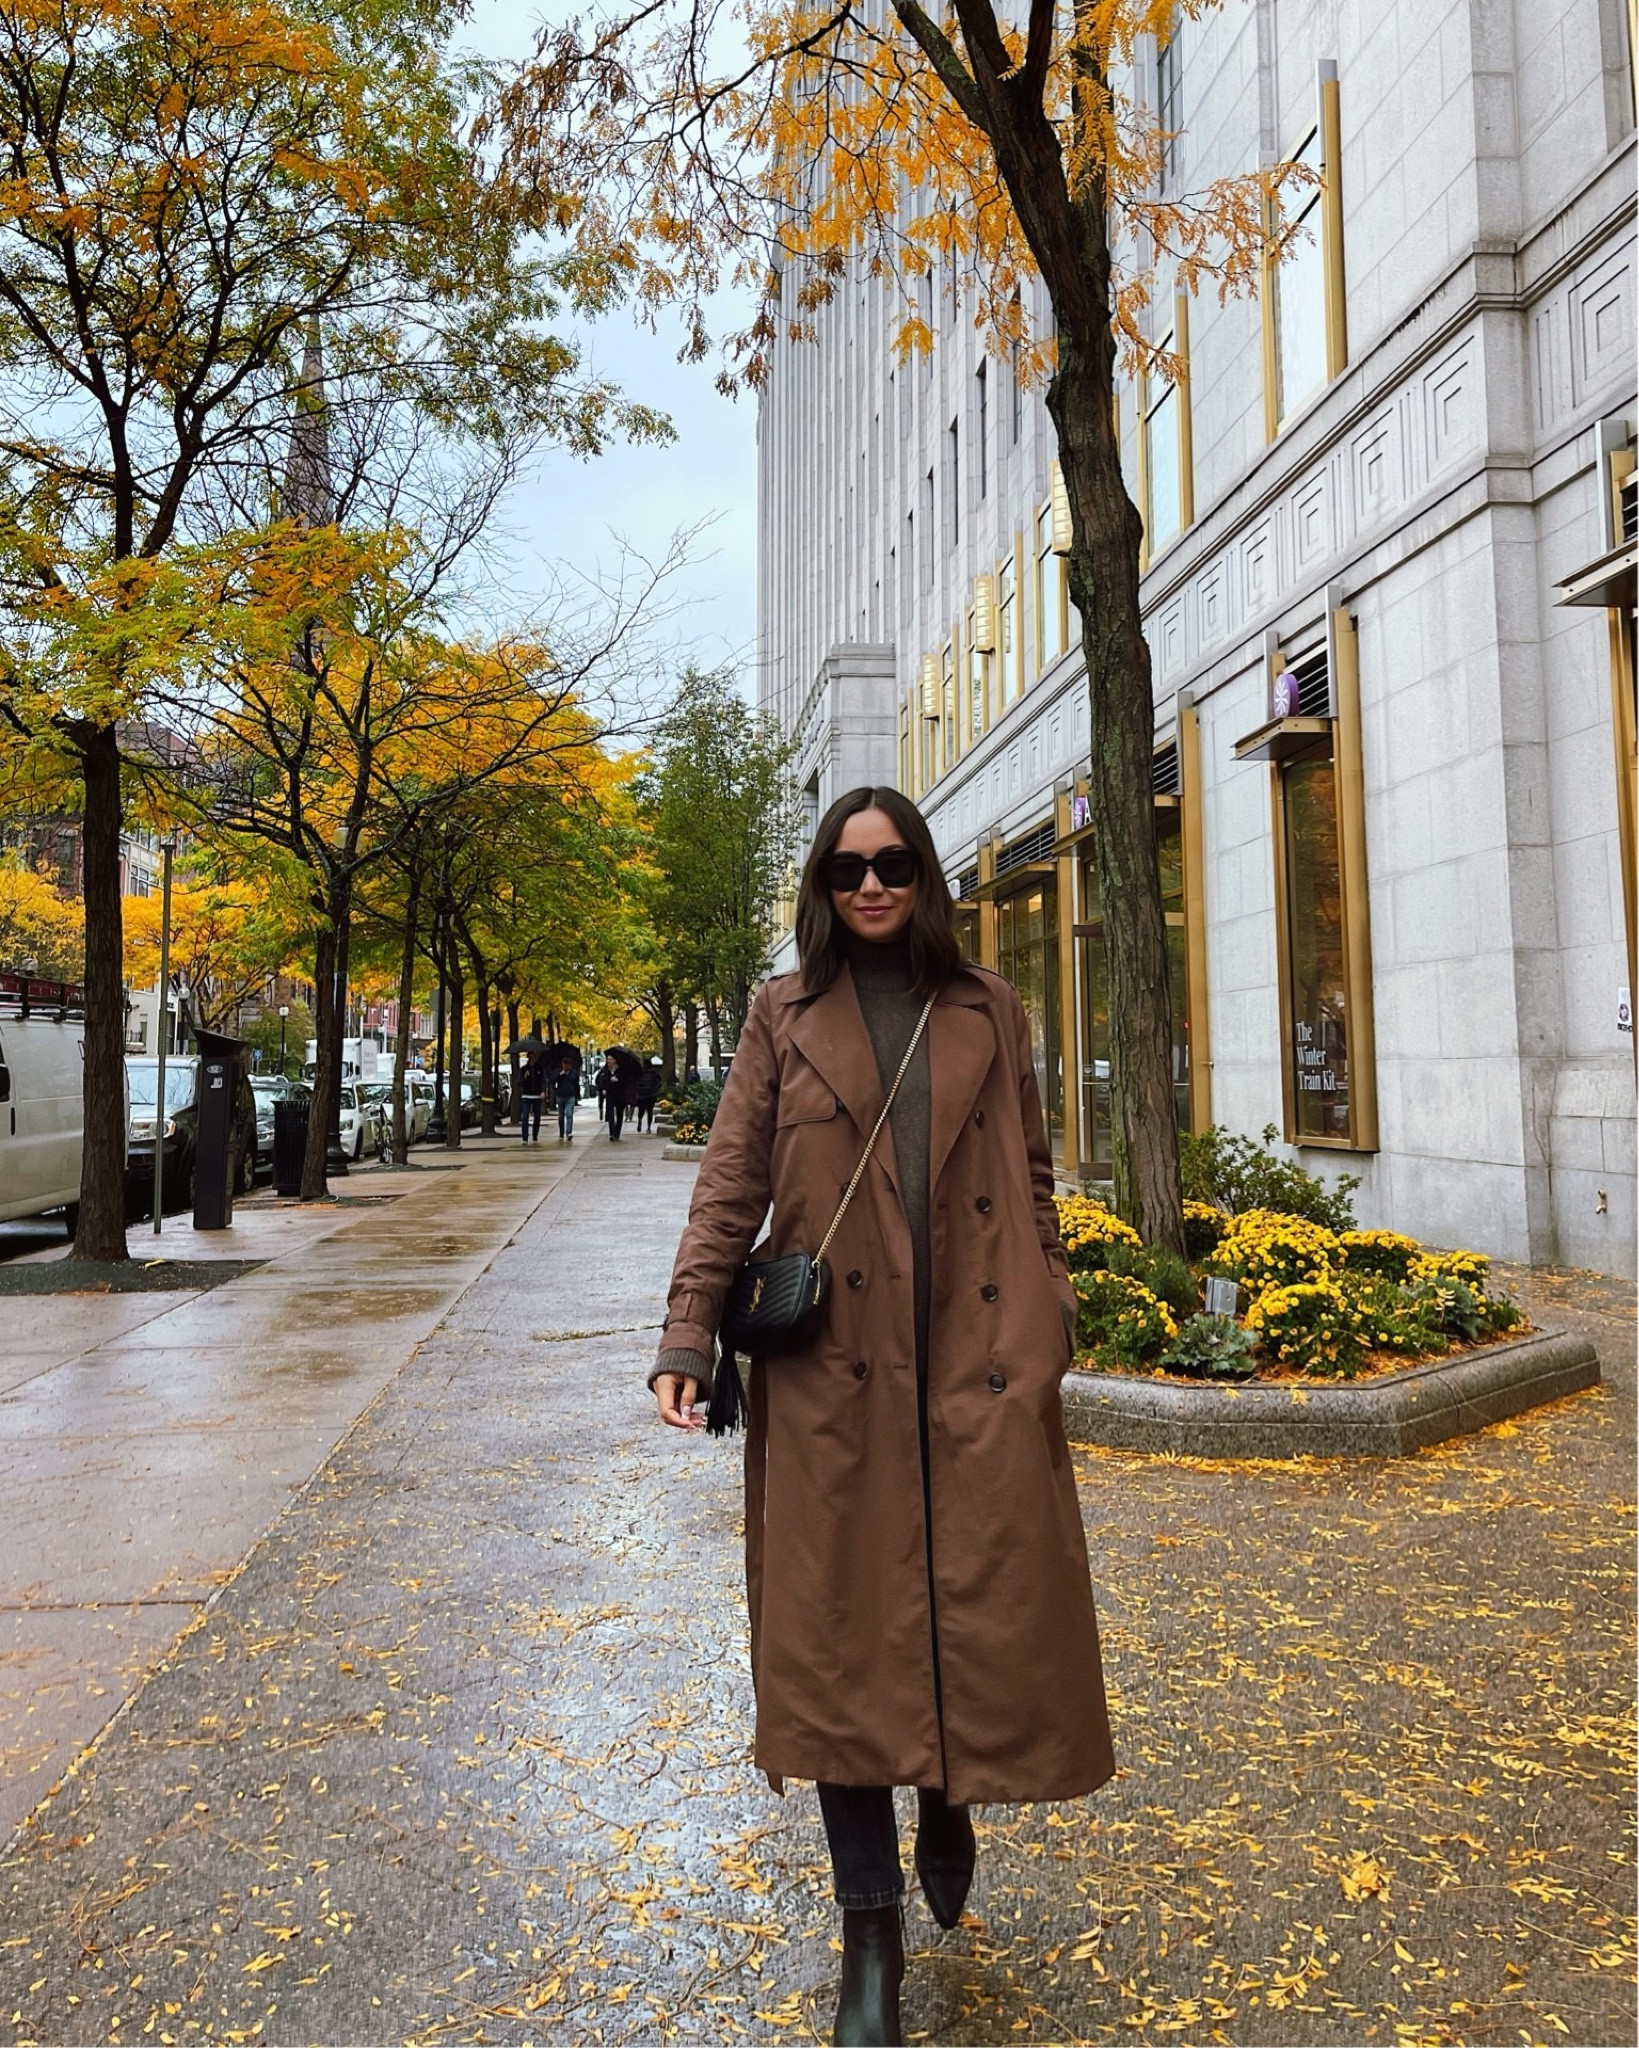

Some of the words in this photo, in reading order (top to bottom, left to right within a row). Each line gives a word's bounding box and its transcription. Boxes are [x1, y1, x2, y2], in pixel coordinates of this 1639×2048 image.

[1296, 1021, 1312, 1041] The
[1296, 1045, 1326, 1066] Winter
[1297, 1070, 1321, 1090] Train
[1322, 1070, 1336, 1090] Kit
